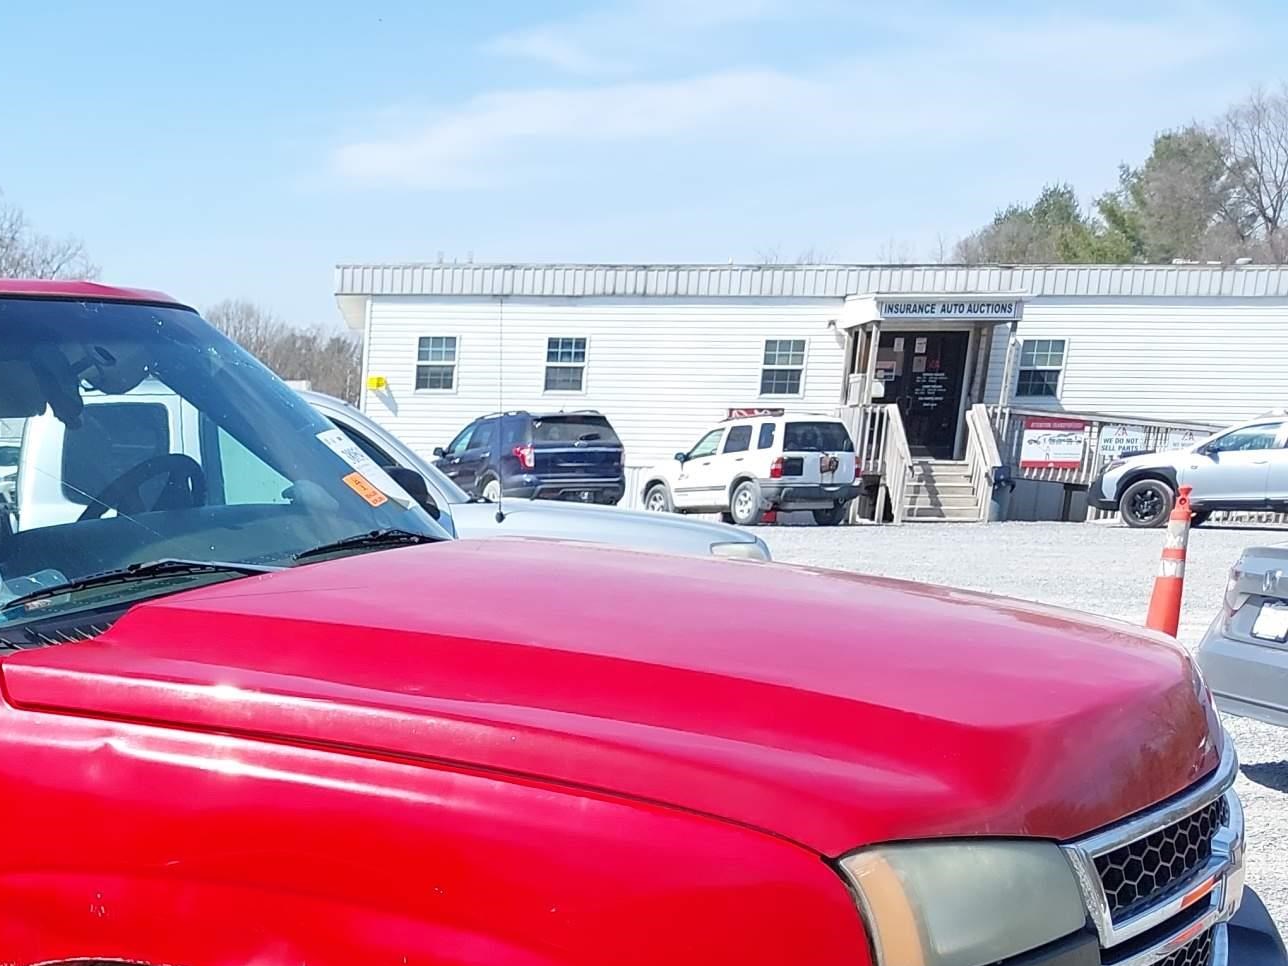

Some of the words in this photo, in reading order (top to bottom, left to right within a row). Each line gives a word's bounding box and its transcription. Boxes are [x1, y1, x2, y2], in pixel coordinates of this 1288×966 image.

[884, 303, 936, 314] INSURANCE
[940, 303, 965, 314] AUTO
[967, 303, 1013, 314] AUCTIONS
